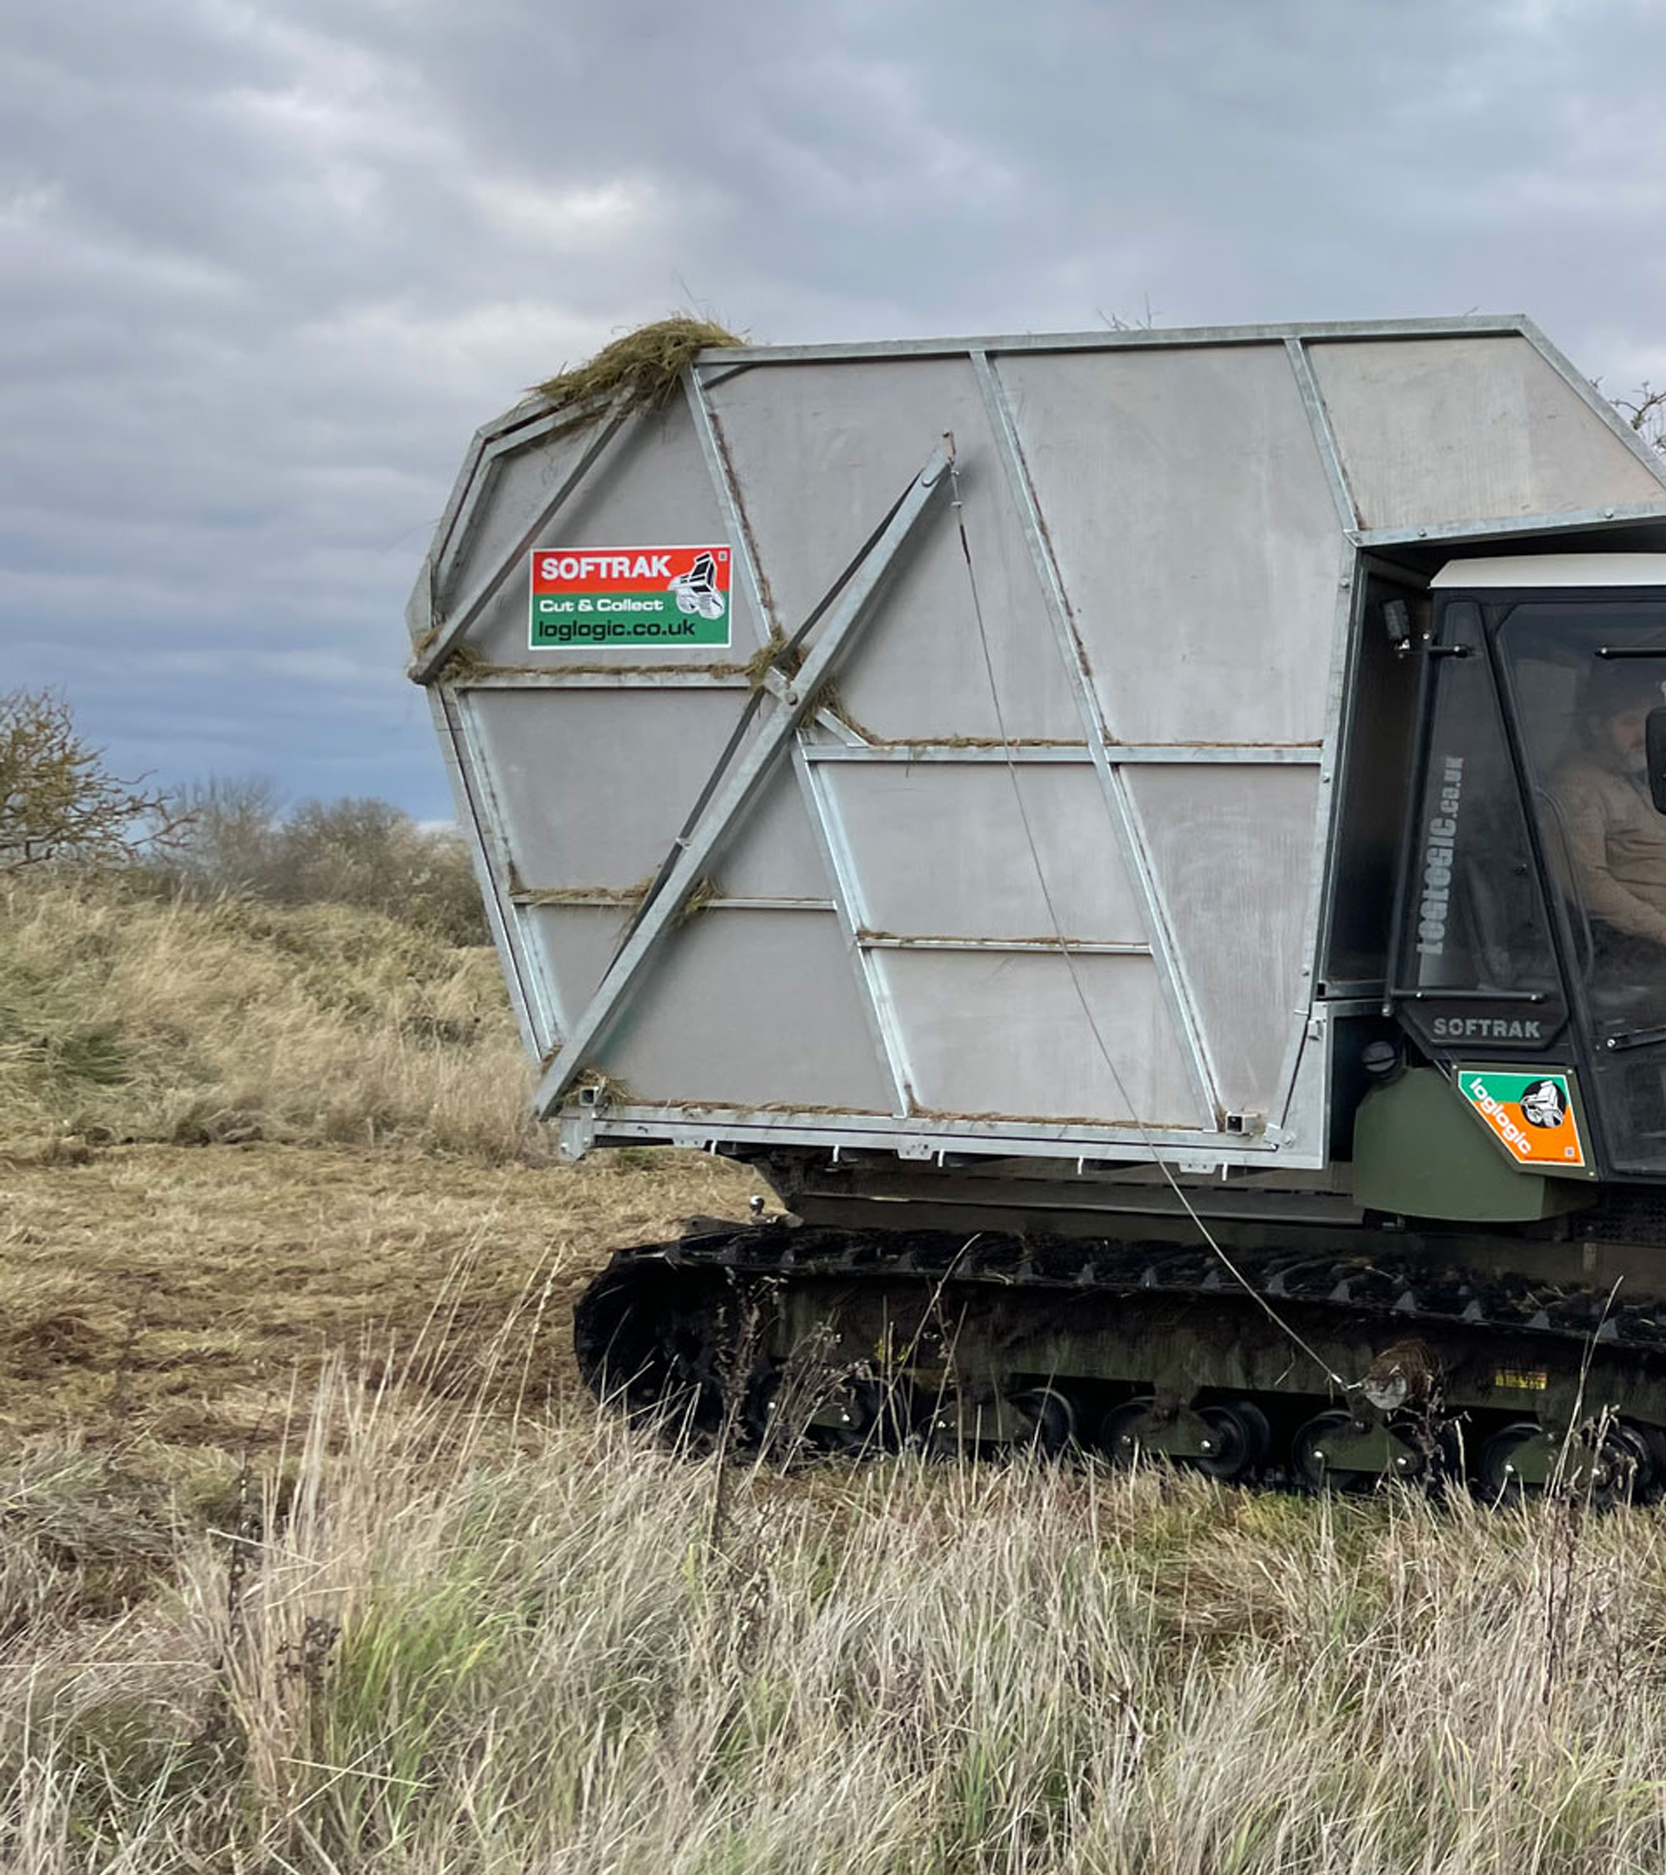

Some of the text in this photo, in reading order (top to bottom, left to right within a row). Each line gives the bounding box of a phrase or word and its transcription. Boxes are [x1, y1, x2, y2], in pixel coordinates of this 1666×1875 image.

[541, 556, 671, 580] SOFTRAK
[540, 598, 664, 612] Cut & Collect
[539, 619, 695, 641] loglogic.co.uk
[1433, 1018, 1541, 1038] SOFTRAK
[1469, 1077, 1532, 1154] loglogic
